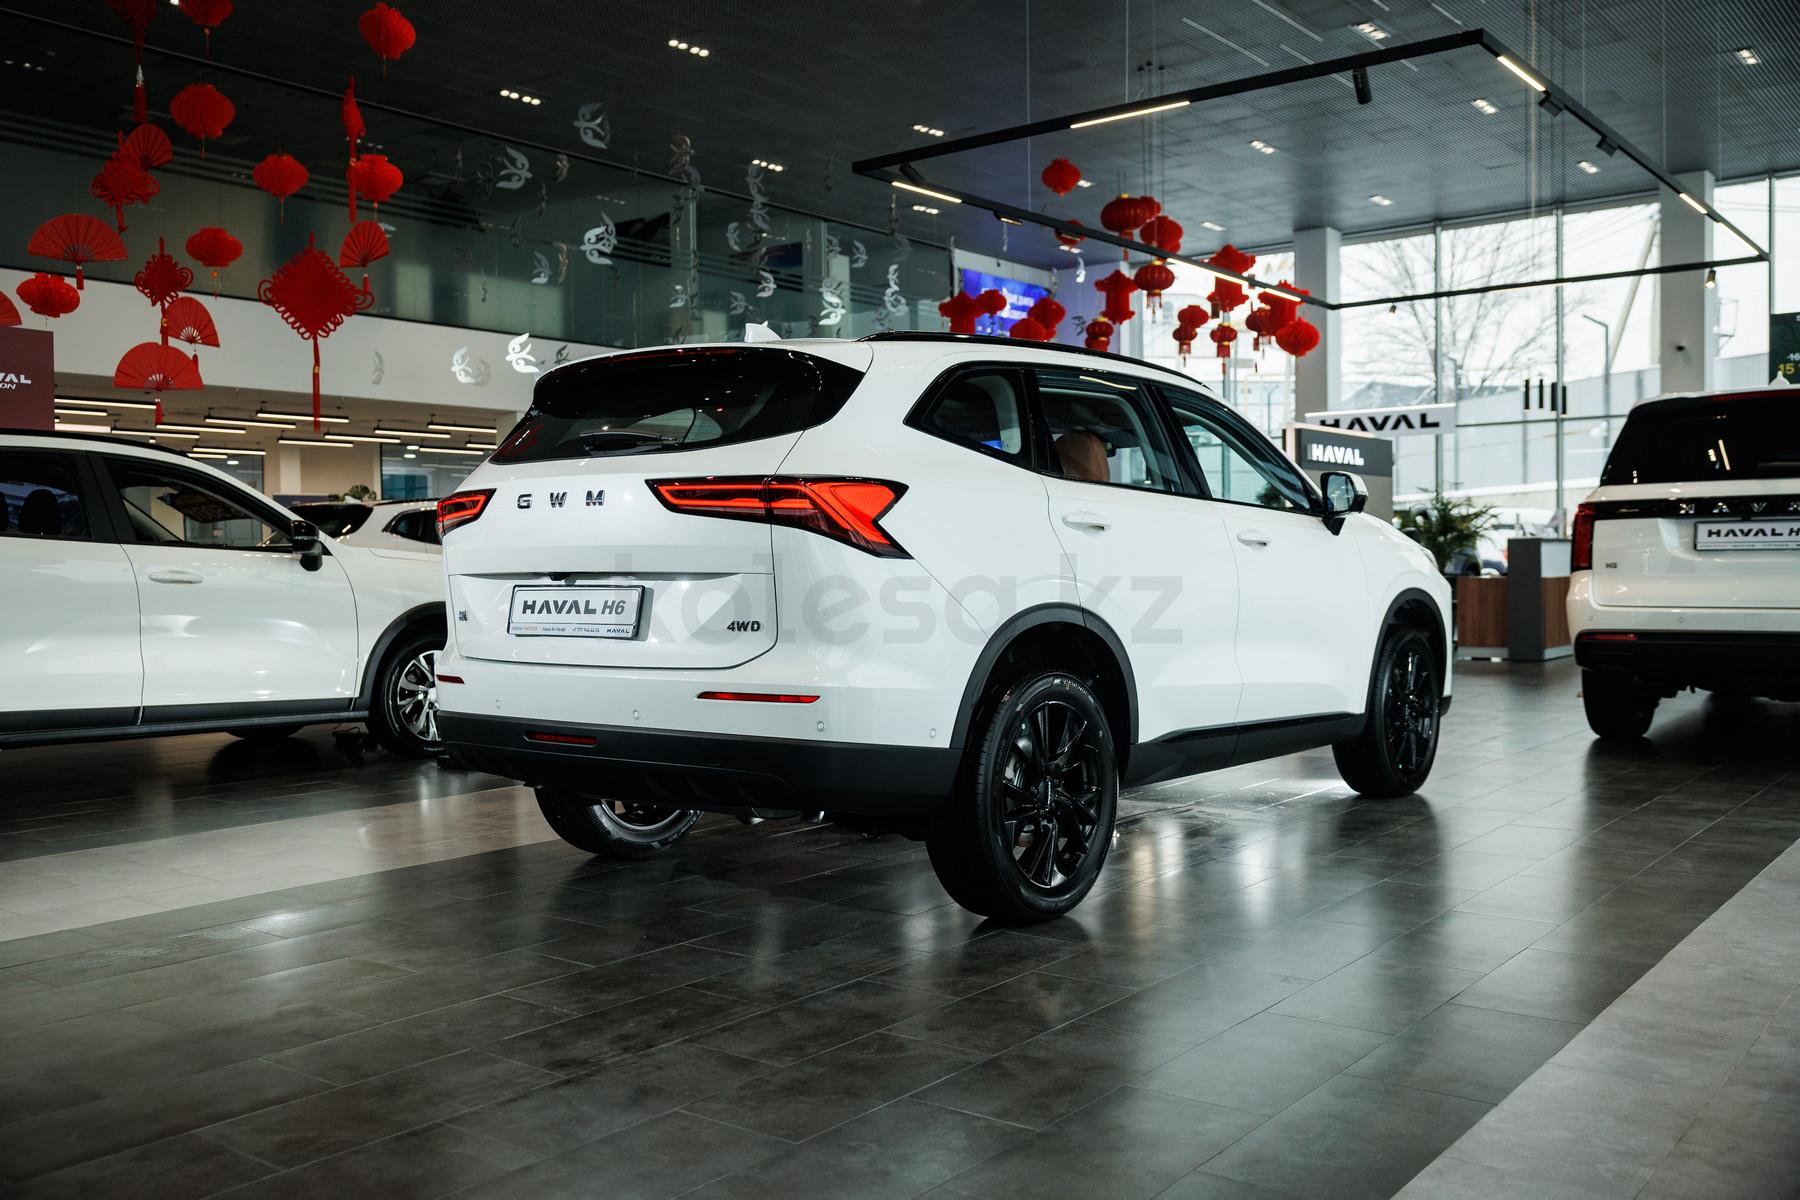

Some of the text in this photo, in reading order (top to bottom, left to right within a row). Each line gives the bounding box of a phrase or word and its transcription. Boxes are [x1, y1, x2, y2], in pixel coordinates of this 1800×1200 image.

[1319, 413, 1440, 432] HAVAL
[1310, 443, 1365, 466] HAVAL
[517, 489, 605, 510] GWM
[1707, 527, 1783, 538] HAVAL
[522, 600, 626, 615] HAVAL H6
[726, 620, 762, 633] 4WD
